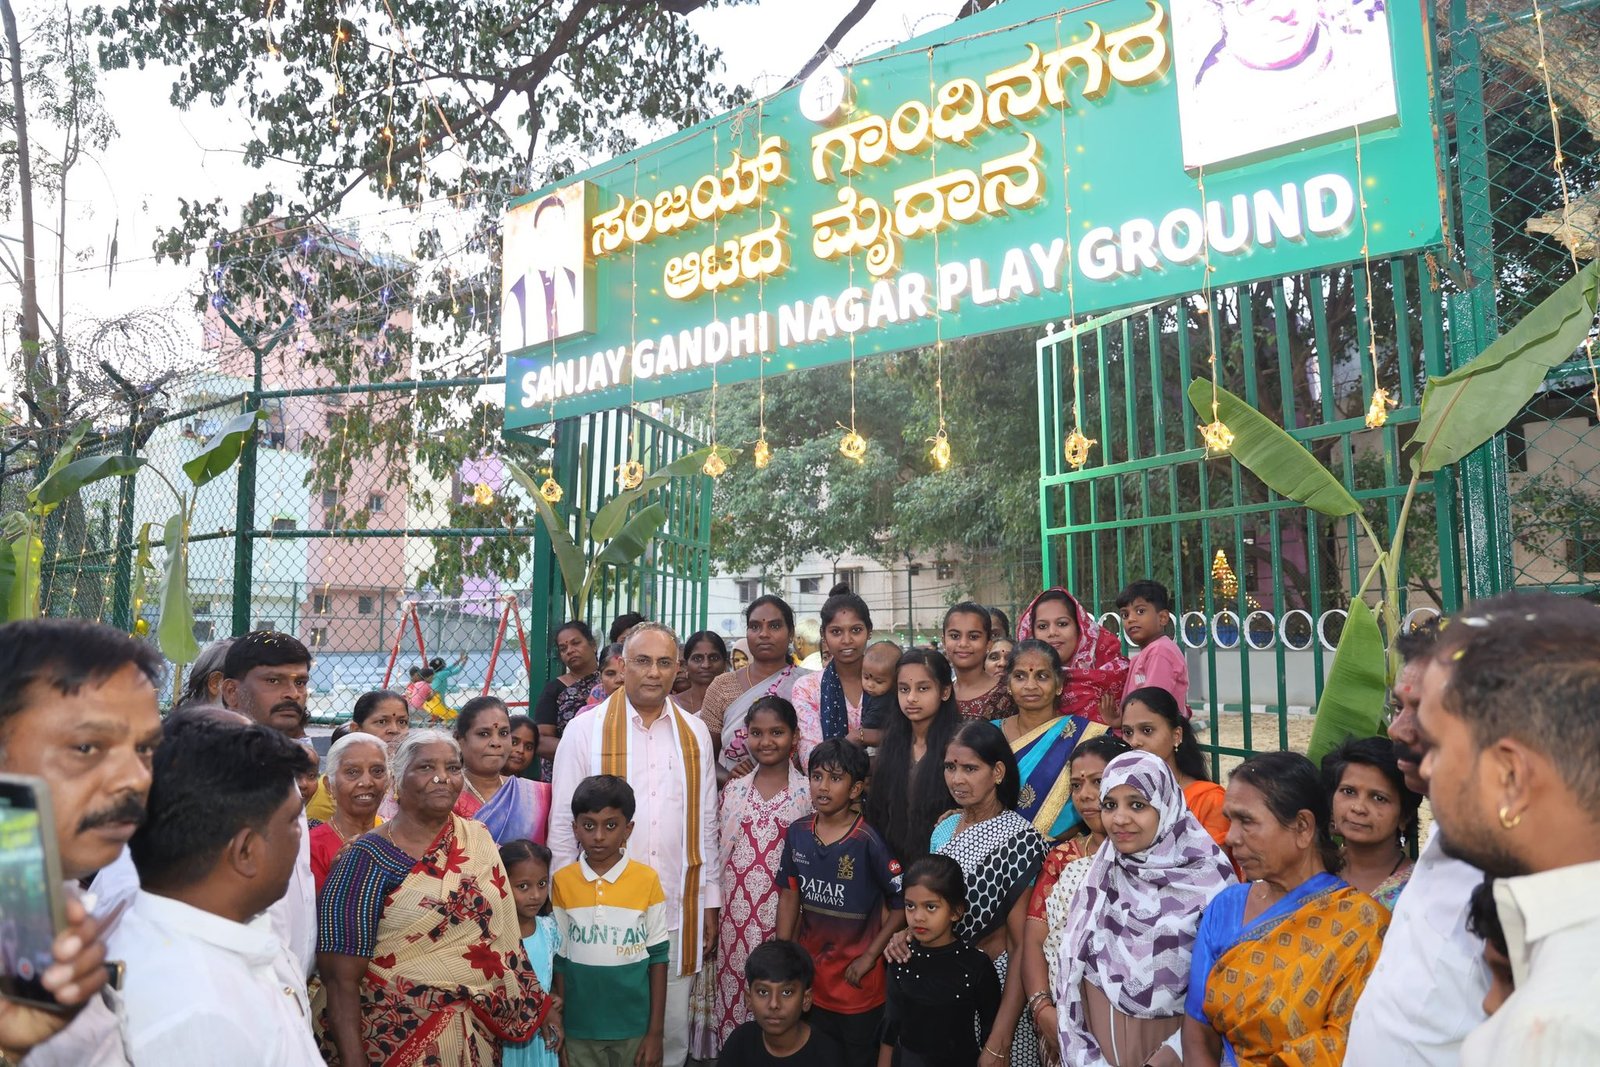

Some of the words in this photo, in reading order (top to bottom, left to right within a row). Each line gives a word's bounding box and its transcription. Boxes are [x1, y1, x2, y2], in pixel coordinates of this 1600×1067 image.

[591, 135, 783, 257] ಸಂಜಯ್
[811, 1, 1168, 183] ಗಾಂಧಿನಗರ
[663, 209, 782, 299] ಆಟದ
[811, 131, 1040, 277] ಮೈದಾನ
[520, 345, 626, 408] SANJAY
[631, 309, 769, 379] GANDHI
[777, 271, 928, 347] NAGAR
[937, 237, 1065, 312] PLAY
[1077, 173, 1354, 280] GROUND
[804, 891, 845, 907] AIRWAYS
